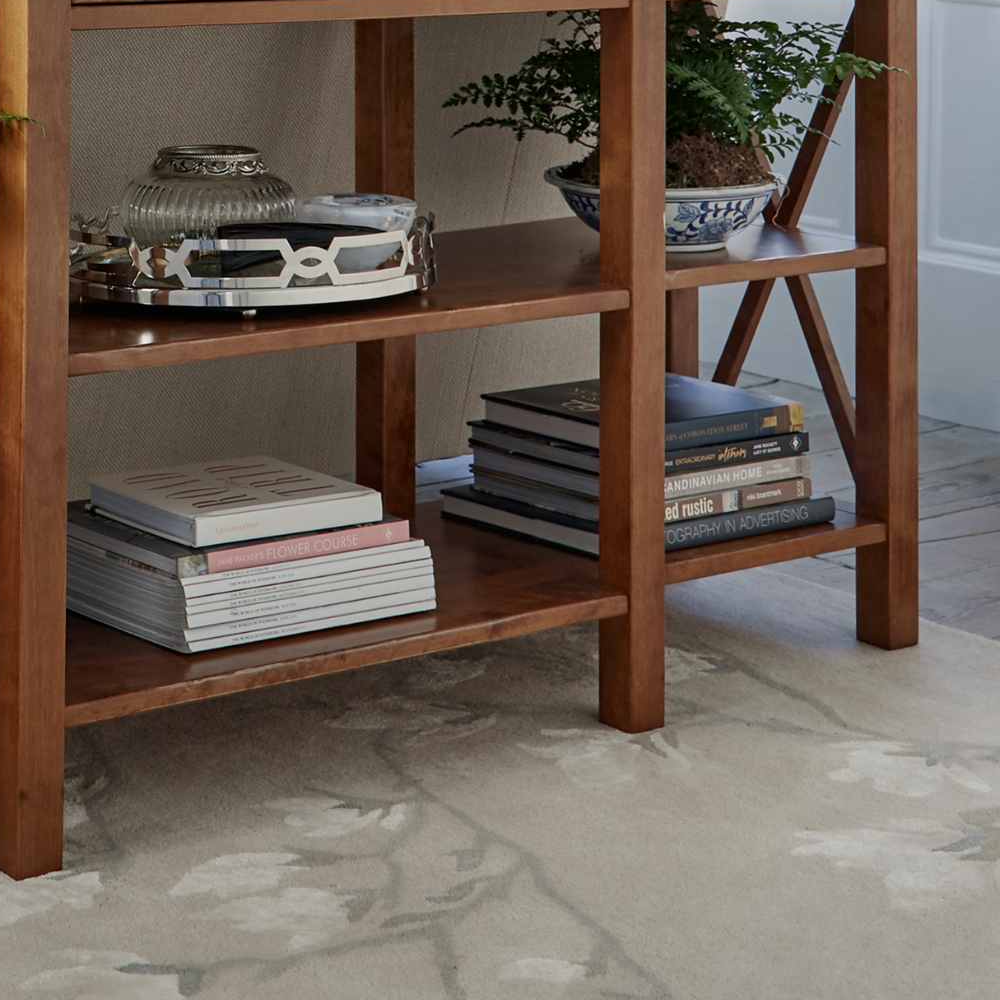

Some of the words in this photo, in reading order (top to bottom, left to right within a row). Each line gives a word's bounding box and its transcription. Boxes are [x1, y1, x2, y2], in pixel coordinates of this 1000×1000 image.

[684, 427, 725, 438] CORONATION
[726, 422, 748, 432] STREET
[675, 454, 716, 465] EXTRAORDINARY
[664, 472, 730, 492] ANDINAVIAN
[733, 467, 762, 480] HOME
[664, 502, 679, 520] ed
[682, 497, 714, 517] rustic
[664, 522, 721, 544] OGRAPHY
[725, 519, 736, 533] IN
[739, 505, 809, 531] ADVERTISING
[217, 558, 234, 567] JANE
[235, 552, 264, 562] PACKER'S
[266, 542, 310, 560] FLOWER
[314, 534, 358, 552] COURSE
